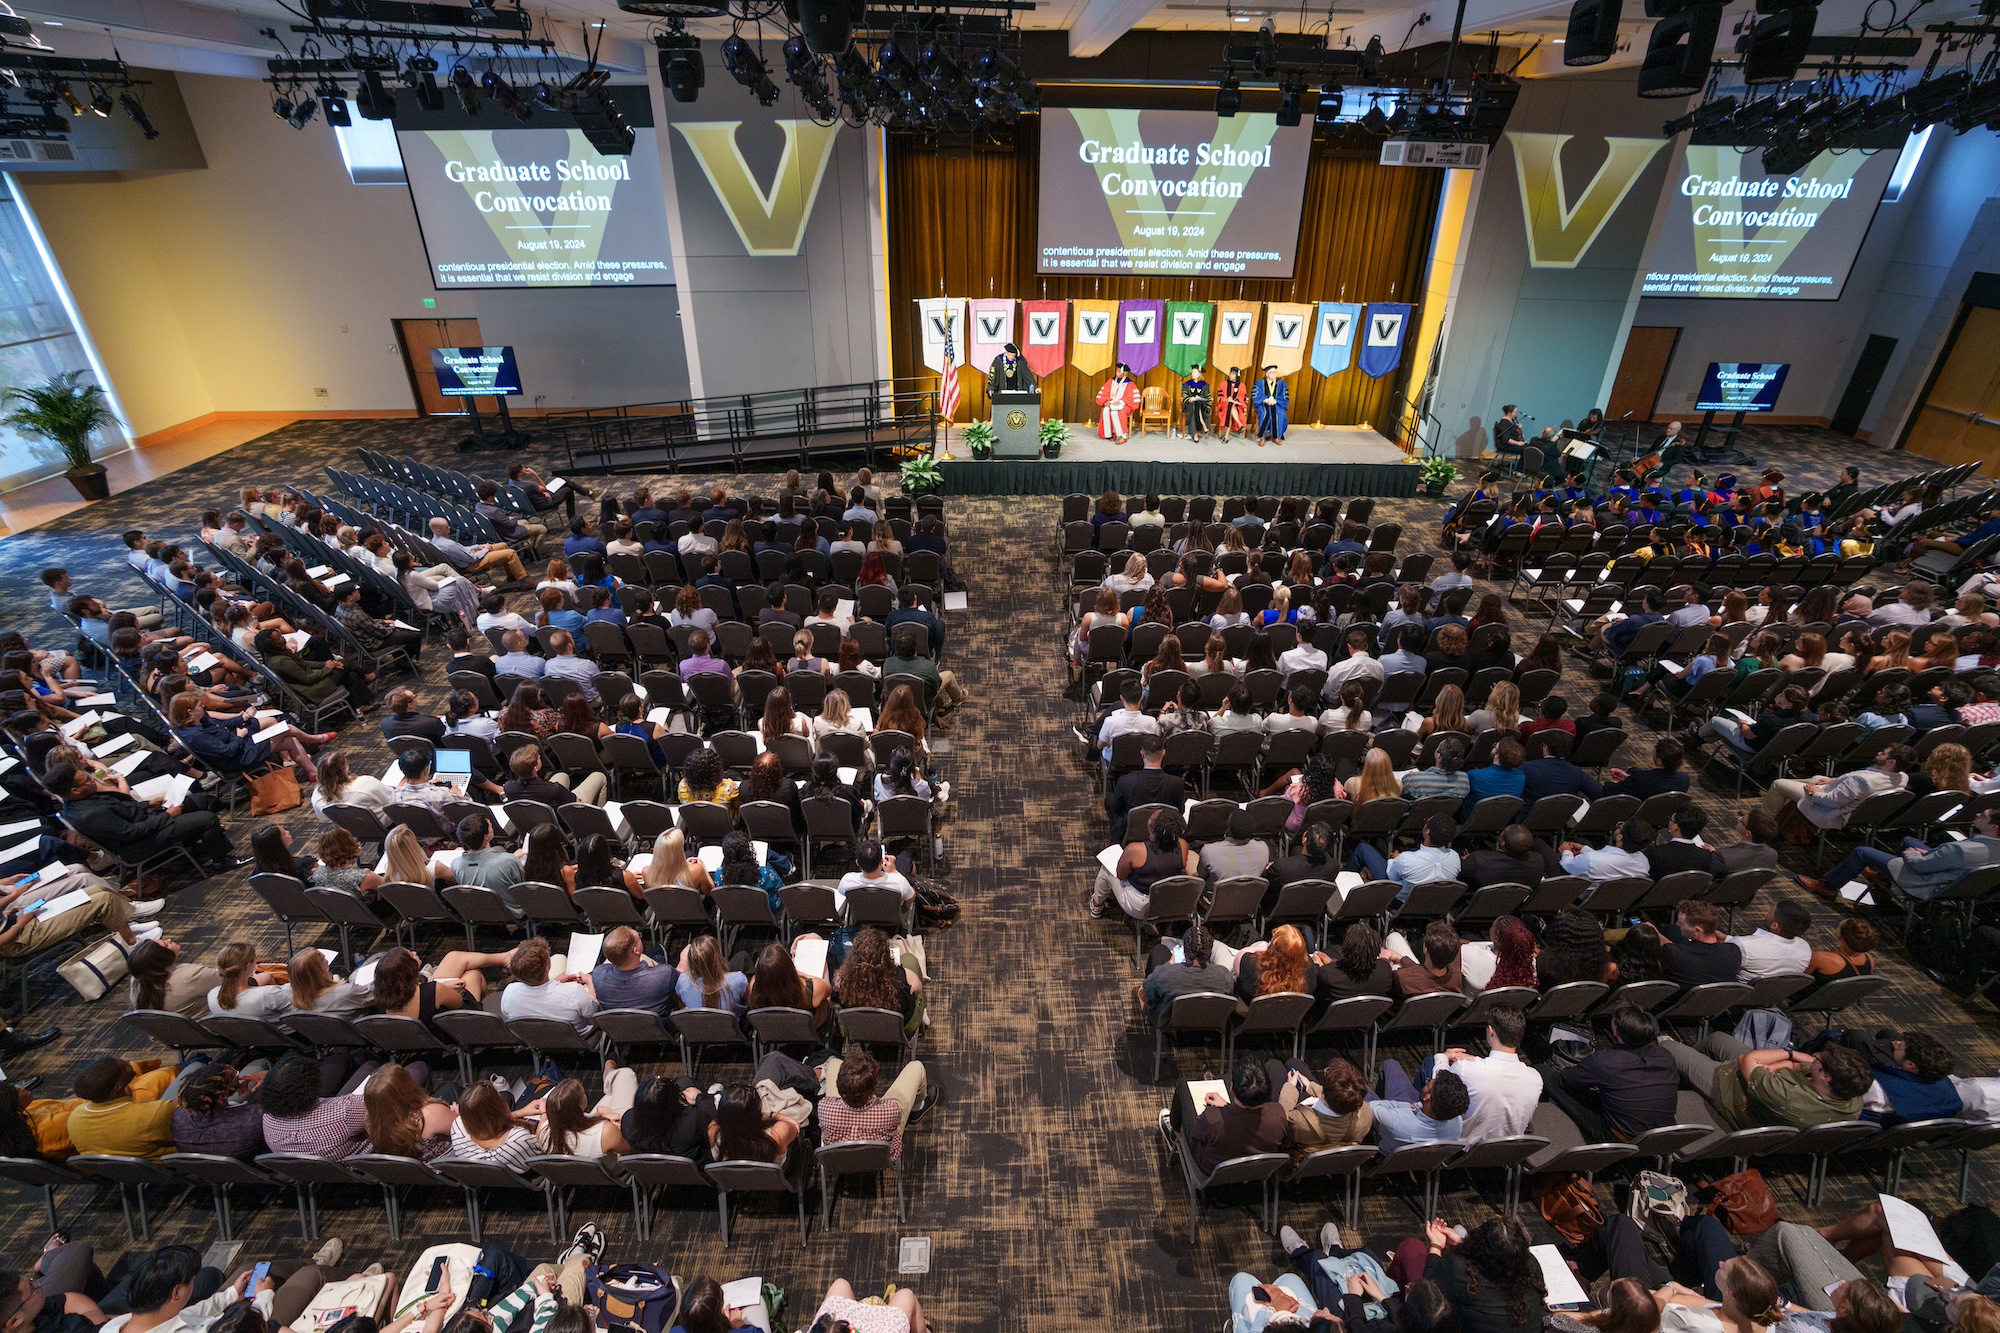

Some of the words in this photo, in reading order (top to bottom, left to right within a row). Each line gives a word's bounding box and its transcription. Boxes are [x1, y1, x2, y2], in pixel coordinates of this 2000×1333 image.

[1079, 140, 1190, 165] Graduate
[1195, 142, 1272, 168] School
[444, 160, 551, 183] Graduate
[556, 159, 630, 182] School
[671, 118, 849, 256] V
[1102, 172, 1243, 199] Convocation
[1680, 174, 1779, 198] Graduate
[1781, 176, 1855, 200] School
[474, 190, 612, 212] Convocation
[1505, 132, 1671, 268] V
[1692, 204, 1818, 228] Convocation
[1133, 225, 1165, 237] August
[1167, 226, 1180, 237] 19,
[1183, 226, 1205, 237] 2024
[518, 240, 546, 252] August
[550, 240, 562, 250] 19,
[564, 240, 585, 250] 2024
[1043, 247, 1093, 256] contentious
[1096, 247, 1146, 258] presidential
[1148, 247, 1183, 258] election.
[1186, 248, 1208, 258] Amid
[1210, 249, 1234, 259] these
[1236, 251, 1281, 261] pressures,
[438, 262, 485, 272] contentious
[488, 262, 536, 272] presidential
[538, 261, 572, 270] election.
[574, 261, 595, 270] Amid
[597, 260, 620, 270] these
[622, 261, 667, 271] pressures,
[1043, 258, 1048, 267] it
[1050, 258, 1058, 267] is
[1060, 259, 1099, 268] essential
[1101, 259, 1118, 268] that
[1135, 260, 1158, 269] resist
[1160, 260, 1193, 270] division
[1195, 261, 1211, 270] and
[1213, 263, 1246, 272] engage
[1709, 252, 1737, 264] August
[1739, 253, 1752, 263] 19,
[1753, 253, 1773, 263] 2024
[441, 274, 447, 282] it
[448, 274, 455, 282] is
[457, 274, 494, 282] essential
[495, 274, 512, 282] that
[512, 274, 526, 282] we
[527, 272, 550, 281] resist
[552, 272, 583, 281] division
[585, 272, 601, 281] and
[603, 274, 634, 282] engage
[1646, 272, 1670, 281] ntious
[1671, 273, 1716, 282] presidential
[1717, 274, 1748, 282] election.
[1749, 274, 1771, 283] Amid
[1771, 275, 1793, 283] these
[1792, 276, 1833, 285] pressures,
[1642, 283, 1672, 292] ssential
[1672, 283, 1688, 292] that
[1702, 284, 1723, 293] resist
[1724, 284, 1753, 293] division
[1754, 285, 1770, 294] and
[1770, 286, 1800, 295] engage
[930, 316, 956, 337] V
[979, 316, 1005, 337] V
[1032, 317, 1057, 339] V
[1082, 317, 1108, 338] V
[1129, 317, 1153, 338] V
[1177, 318, 1203, 338] V
[1225, 318, 1252, 338] V
[1276, 320, 1300, 341] V
[1326, 319, 1349, 339] V
[1375, 320, 1399, 341] V
[443, 357, 478, 365] Graduate
[479, 355, 504, 364] School
[1717, 371, 1751, 379] Graduate
[1752, 372, 1776, 380] School
[1721, 381, 1765, 389] Convocation
